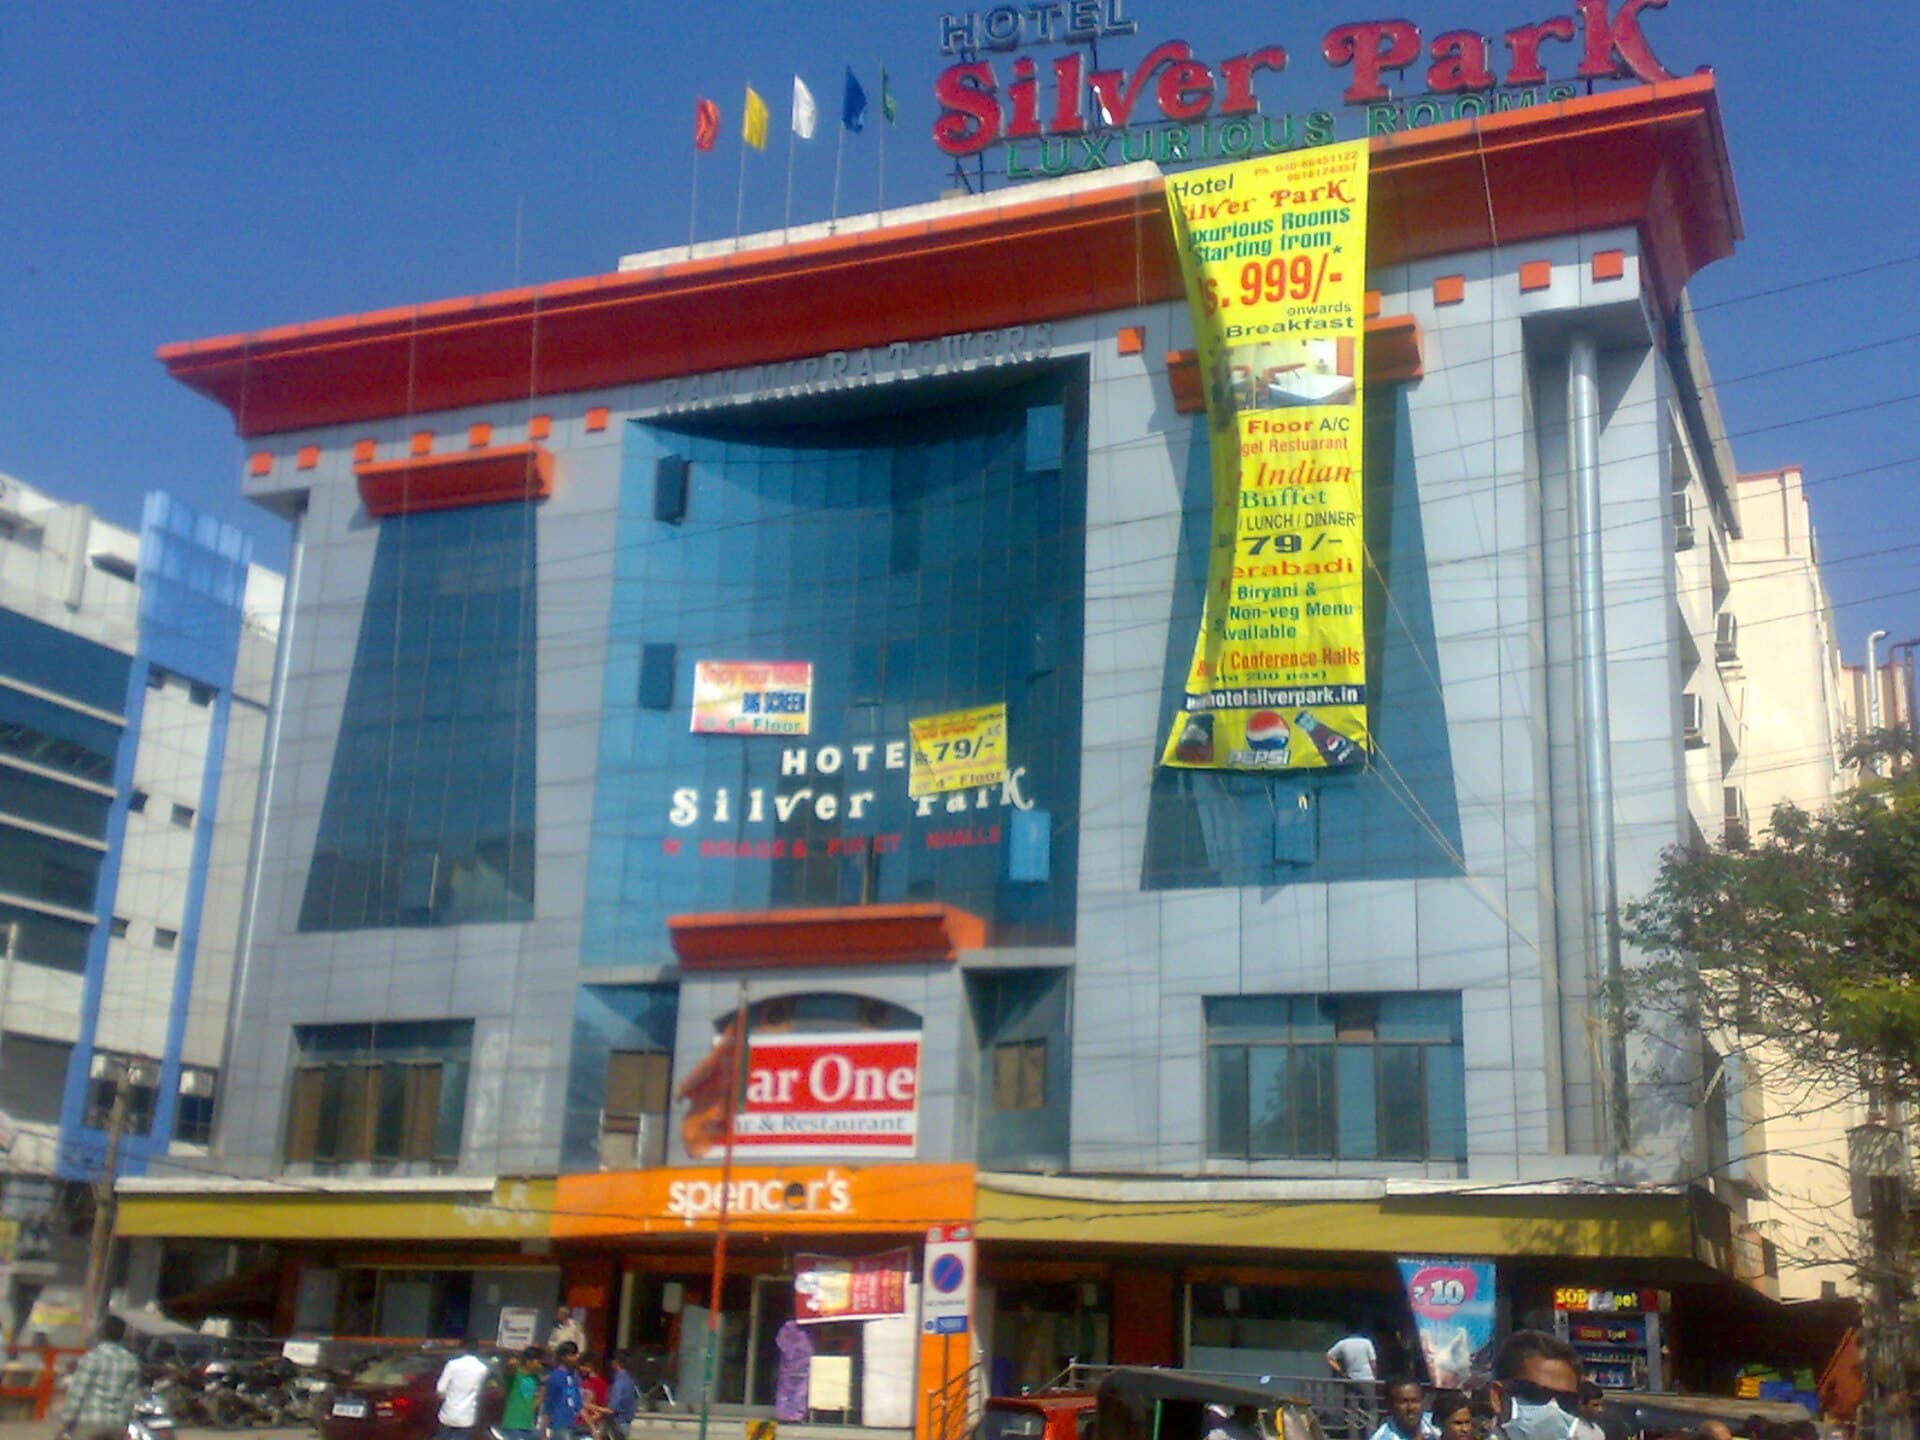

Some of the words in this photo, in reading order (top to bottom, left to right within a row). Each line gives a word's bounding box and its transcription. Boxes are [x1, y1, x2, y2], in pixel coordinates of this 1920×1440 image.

[940, 0, 1138, 55] HOTEL
[933, 38, 1290, 156] Silver
[1322, 0, 1714, 106] Park
[1007, 110, 1335, 179] LUXURIOUS
[1174, 173, 1235, 197] Hotel
[1185, 198, 1257, 221] ilver
[1270, 179, 1355, 208] Park
[1191, 217, 1274, 246] uxurious
[1281, 206, 1350, 231] Rooms
[1281, 232, 1332, 250] from
[1287, 302, 1352, 316] onwards
[1226, 317, 1354, 338] Breakfast
[1247, 420, 1314, 434] Floor
[1319, 417, 1350, 431] A/C
[1256, 459, 1352, 487] Indian
[1242, 487, 1327, 508] Buffet
[1246, 514, 1293, 530] LUNCH
[1305, 511, 1356, 528] DINNER
[1232, 558, 1354, 579] erabadi
[1238, 582, 1298, 602] Biryani
[1230, 603, 1300, 620] Non-veg
[1306, 601, 1353, 617] Menu
[1231, 651, 1317, 671] Conference
[782, 742, 905, 775] HOTE
[669, 787, 874, 827] Silver
[746, 1066, 799, 1102] ar
[808, 1053, 915, 1103] One
[782, 1114, 904, 1132] Restaurant
[667, 1170, 850, 1227] spencer's
